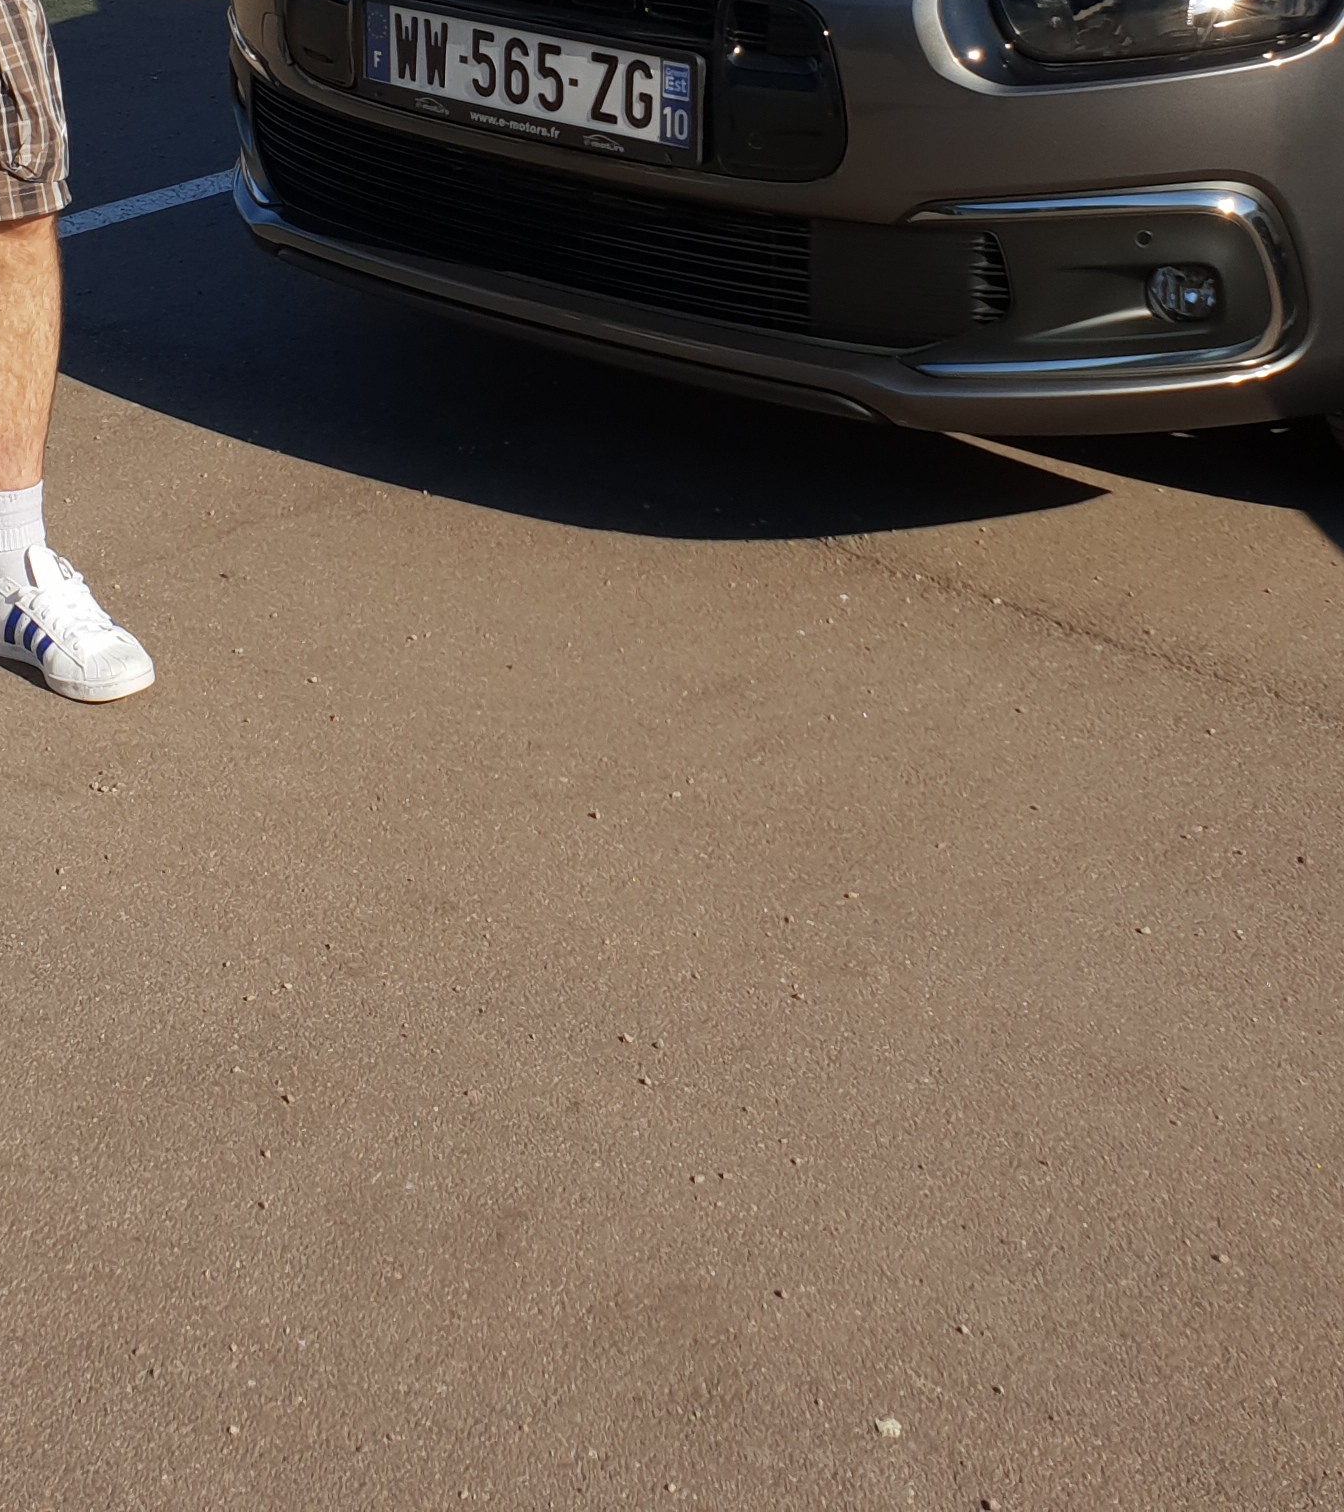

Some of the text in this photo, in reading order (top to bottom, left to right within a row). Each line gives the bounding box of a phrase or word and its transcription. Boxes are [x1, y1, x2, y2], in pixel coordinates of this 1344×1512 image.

[372, 50, 382, 68] F
[394, 12, 654, 129] WW-565-ZG
[665, 76, 687, 93] Est
[469, 110, 561, 139] www.e-motors.fr
[663, 106, 689, 141] 10
